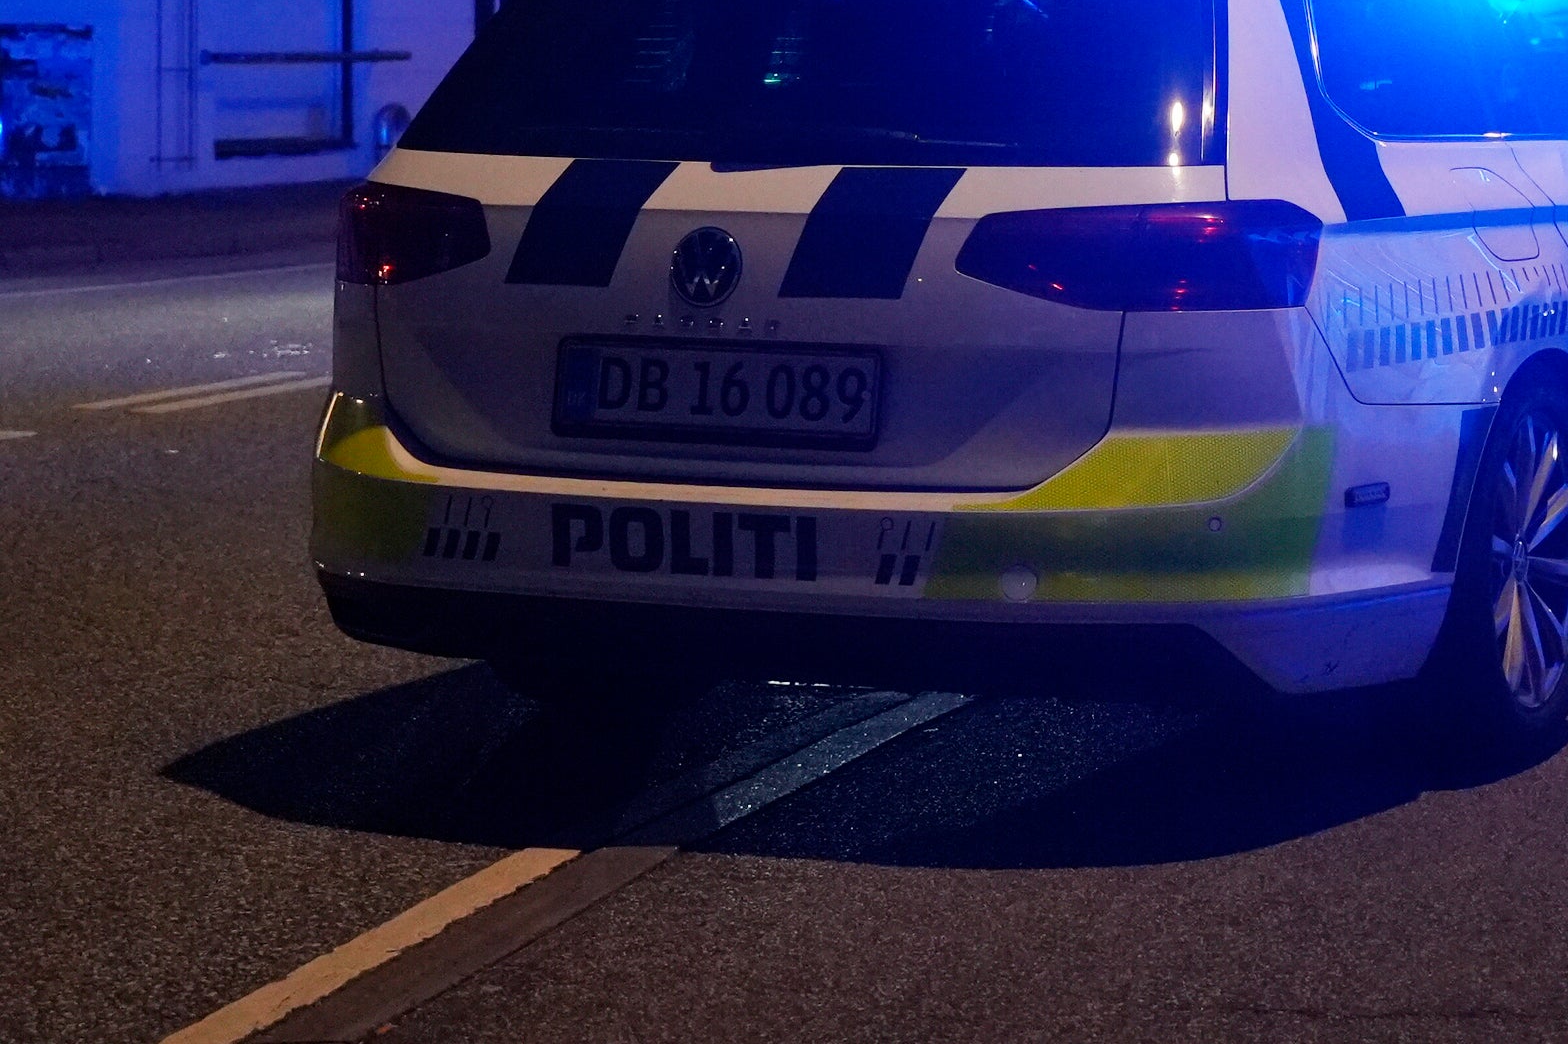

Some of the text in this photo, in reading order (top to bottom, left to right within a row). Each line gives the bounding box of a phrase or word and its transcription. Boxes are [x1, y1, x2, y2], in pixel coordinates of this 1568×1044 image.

[598, 357, 868, 423] DB 16 089
[551, 503, 817, 581] POLITI
